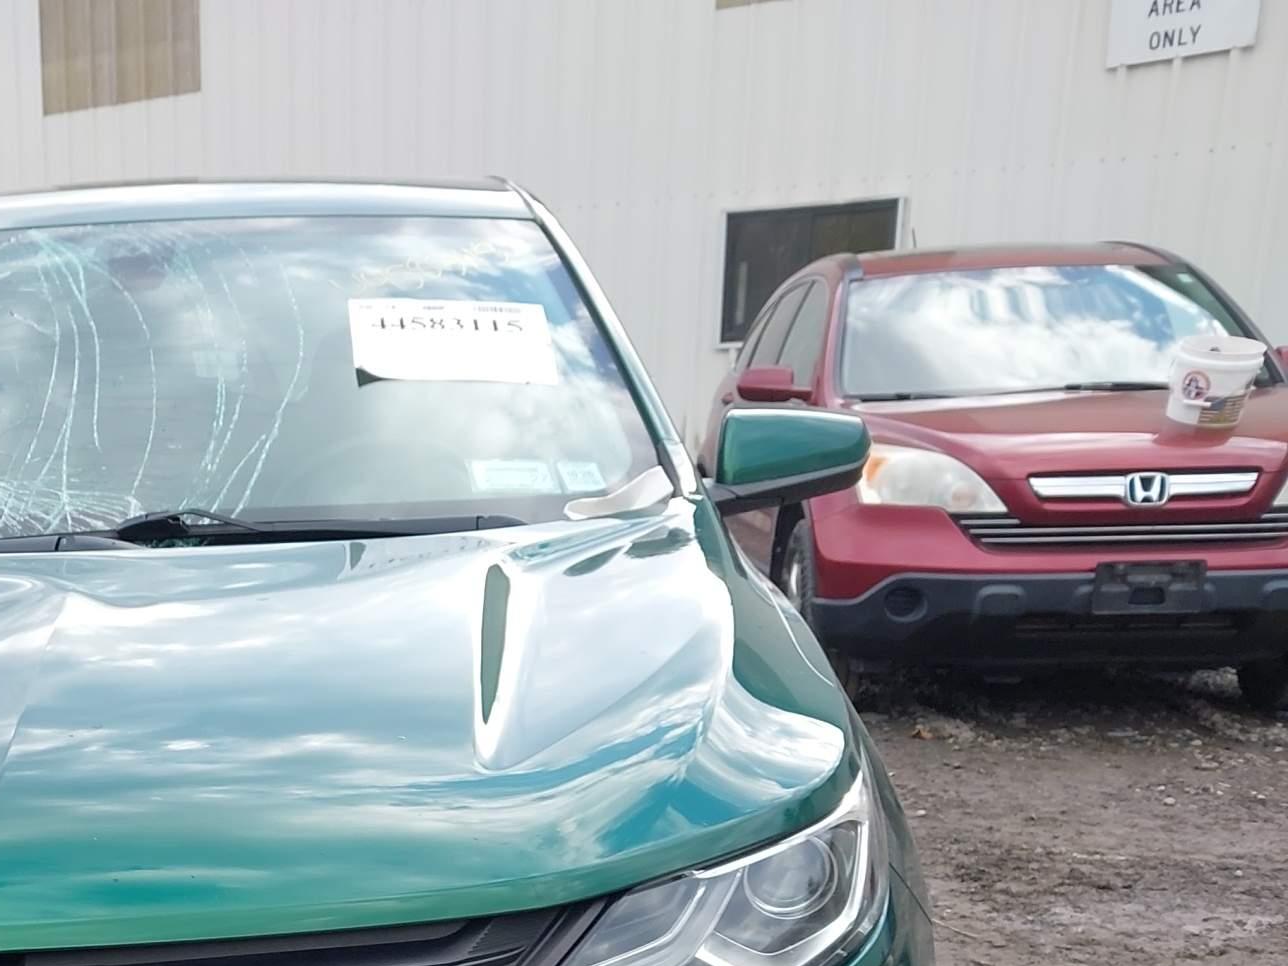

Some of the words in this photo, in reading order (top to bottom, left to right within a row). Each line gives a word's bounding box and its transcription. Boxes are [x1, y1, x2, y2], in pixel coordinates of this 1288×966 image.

[1148, 0, 1202, 18] AREA
[1149, 24, 1202, 51] ONLY
[371, 316, 524, 333] 44583115
